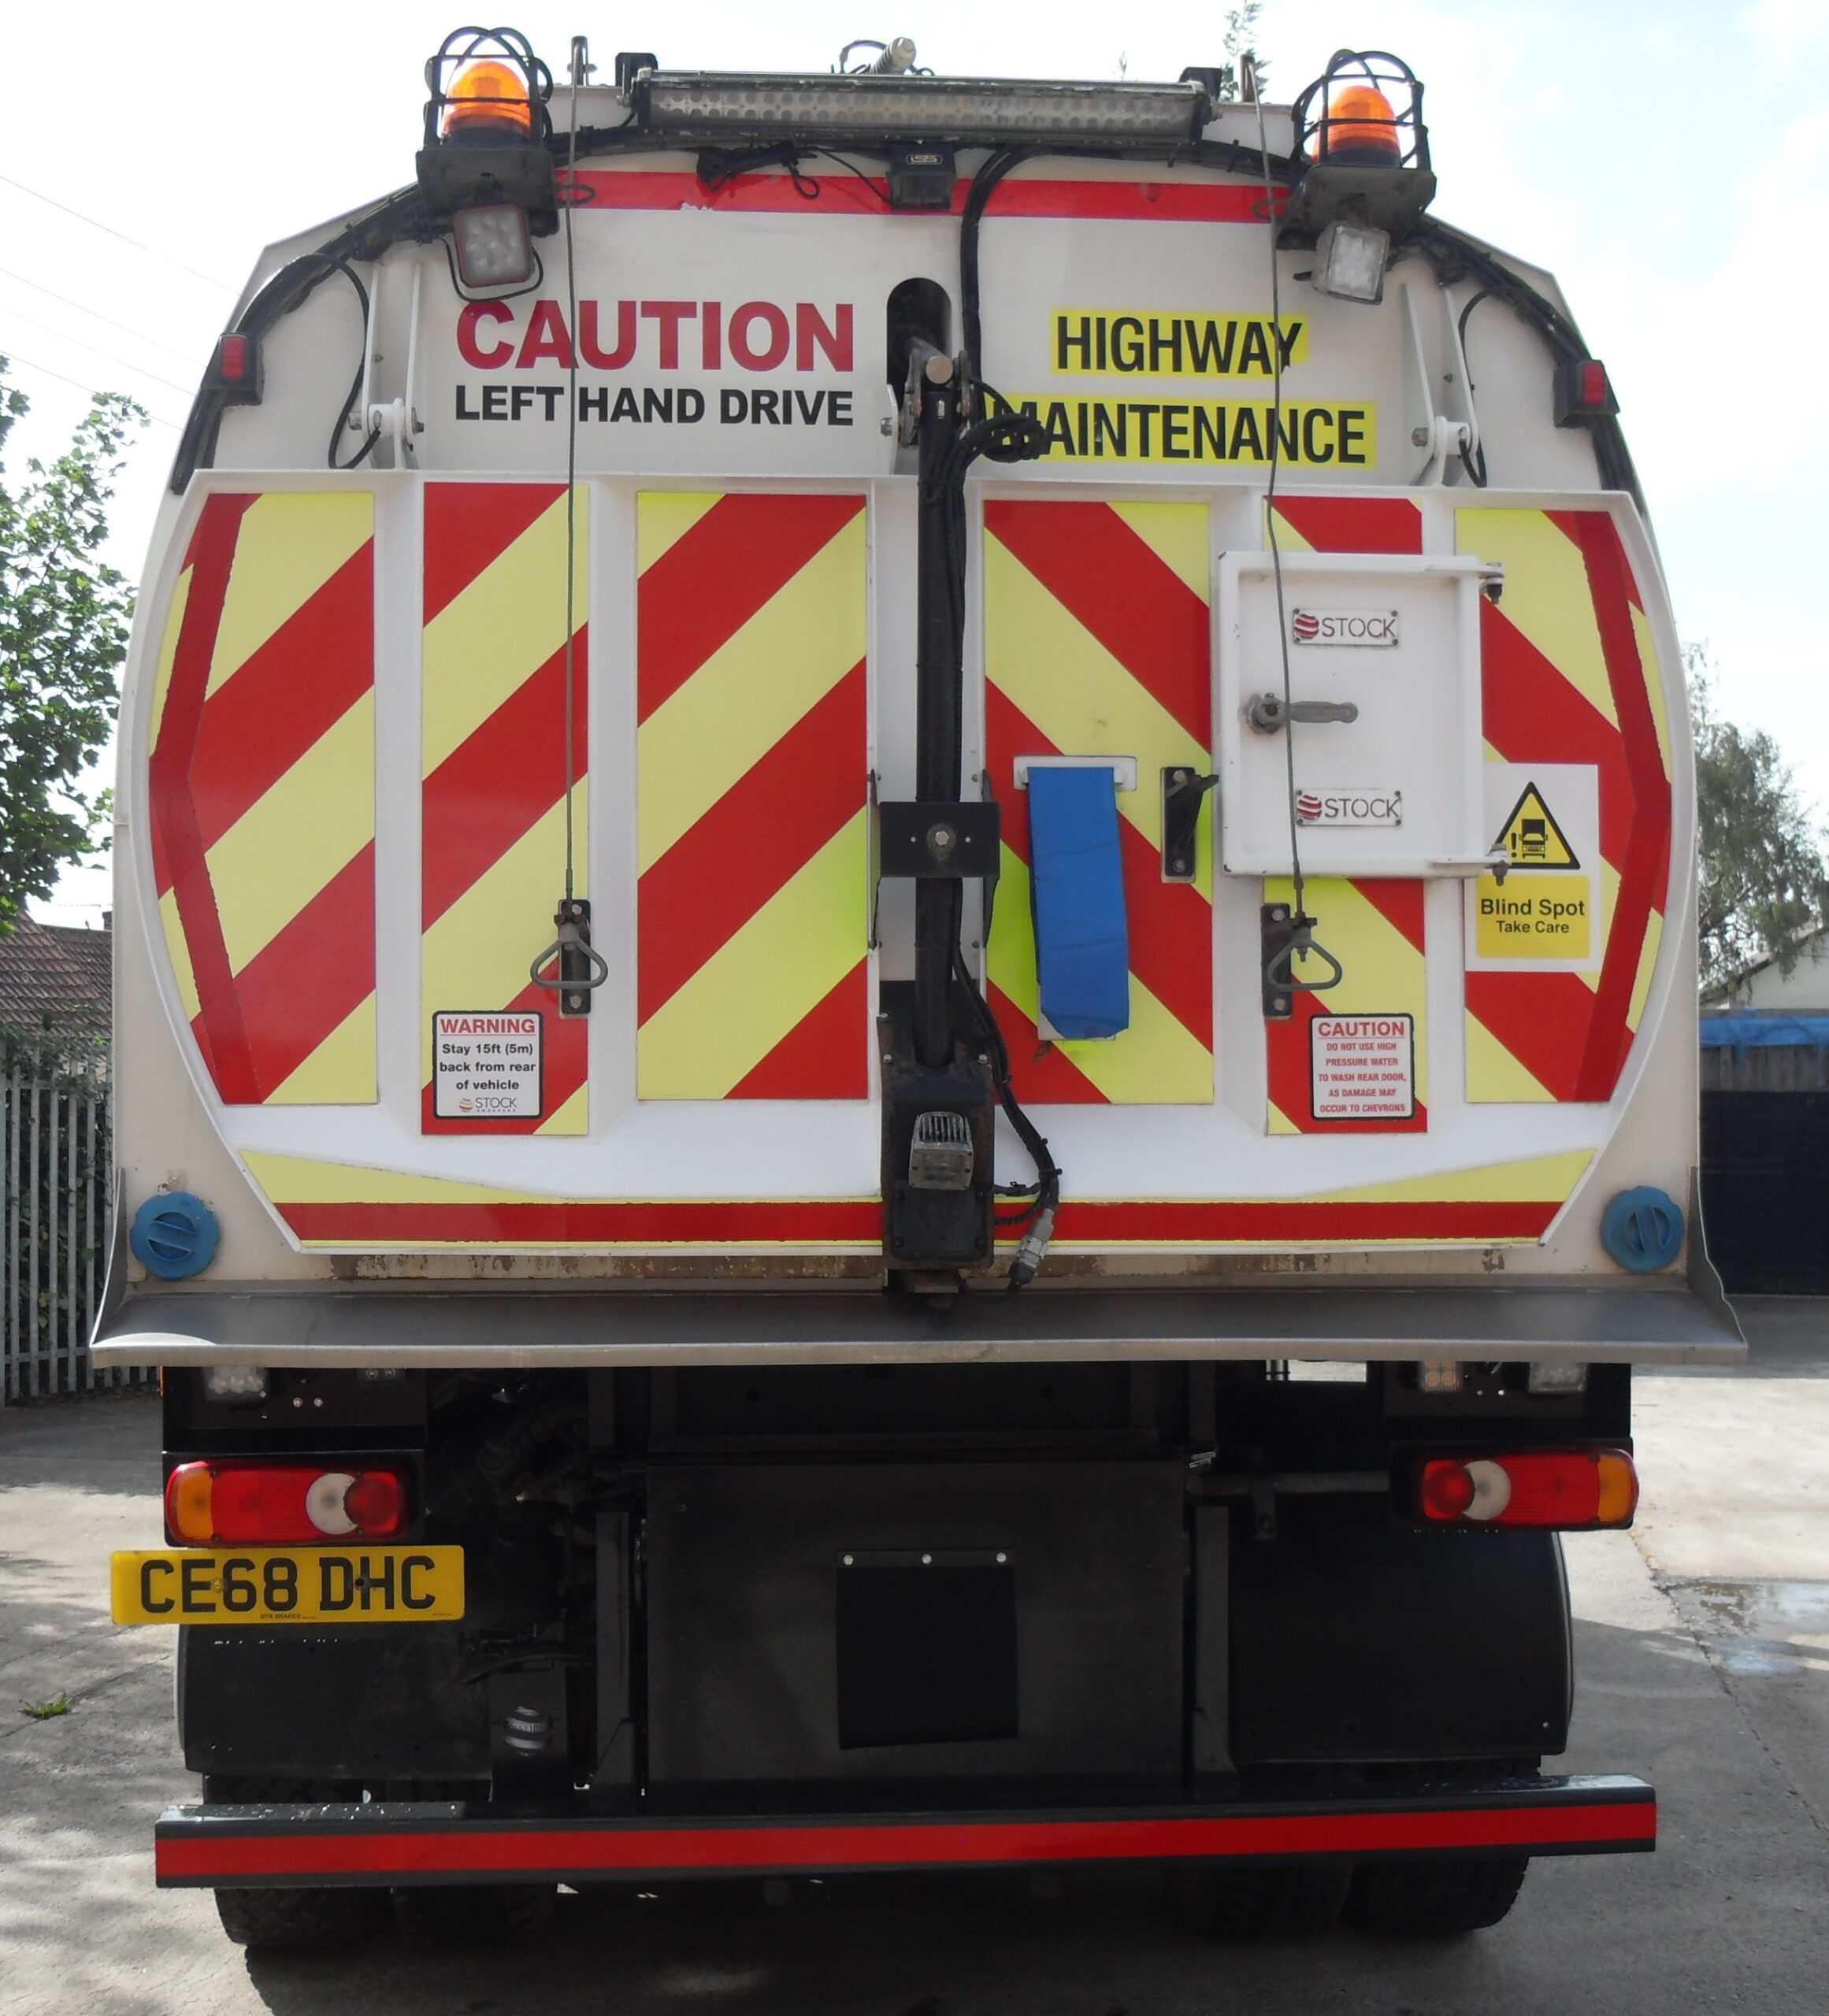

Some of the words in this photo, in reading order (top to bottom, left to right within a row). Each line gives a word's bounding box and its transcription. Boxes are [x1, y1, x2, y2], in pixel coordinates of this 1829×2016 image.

[456, 300, 854, 372] CAUTION
[1057, 316, 1303, 374] HIGHWAY
[455, 385, 564, 421] LEFT
[578, 387, 705, 423] HAND
[720, 390, 853, 426] DRIVE
[1321, 617, 1397, 638] STOCK
[1324, 799, 1400, 818] STOCK
[1481, 899, 1532, 915] Blind
[1538, 899, 1585, 920] Spot
[1496, 920, 1530, 933] Take
[1534, 921, 1570, 933] Care
[440, 1018, 536, 1034] WARNING
[1318, 1021, 1404, 1036] CAUTION
[442, 1043, 471, 1056] Stay
[476, 1043, 501, 1054] 15ft
[505, 1043, 533, 1056] (5m)
[1326, 1043, 1338, 1051] DO
[1341, 1043, 1356, 1051] NOT
[440, 1062, 471, 1073] back
[475, 1062, 505, 1072] from
[509, 1063, 536, 1072] rear
[1371, 1058, 1398, 1066] WATER
[1318, 1073, 1329, 1082] TO
[1330, 1073, 1355, 1082] WASH
[1357, 1073, 1379, 1082] REAR
[1382, 1073, 1406, 1082] DOOR,
[455, 1080, 469, 1090] of
[473, 1080, 520, 1090] vehicle
[1329, 1089, 1339, 1098] AS
[1341, 1088, 1377, 1097] DAMAGE
[1378, 1088, 1397, 1097] MAY
[475, 1097, 518, 1109] STOCK
[1320, 1104, 1347, 1113] OCCUR
[1349, 1104, 1360, 1113] TO
[1362, 1103, 1405, 1113] CHEVRONS
[140, 1558, 298, 1614] CE68
[319, 1555, 436, 1611] DHC
